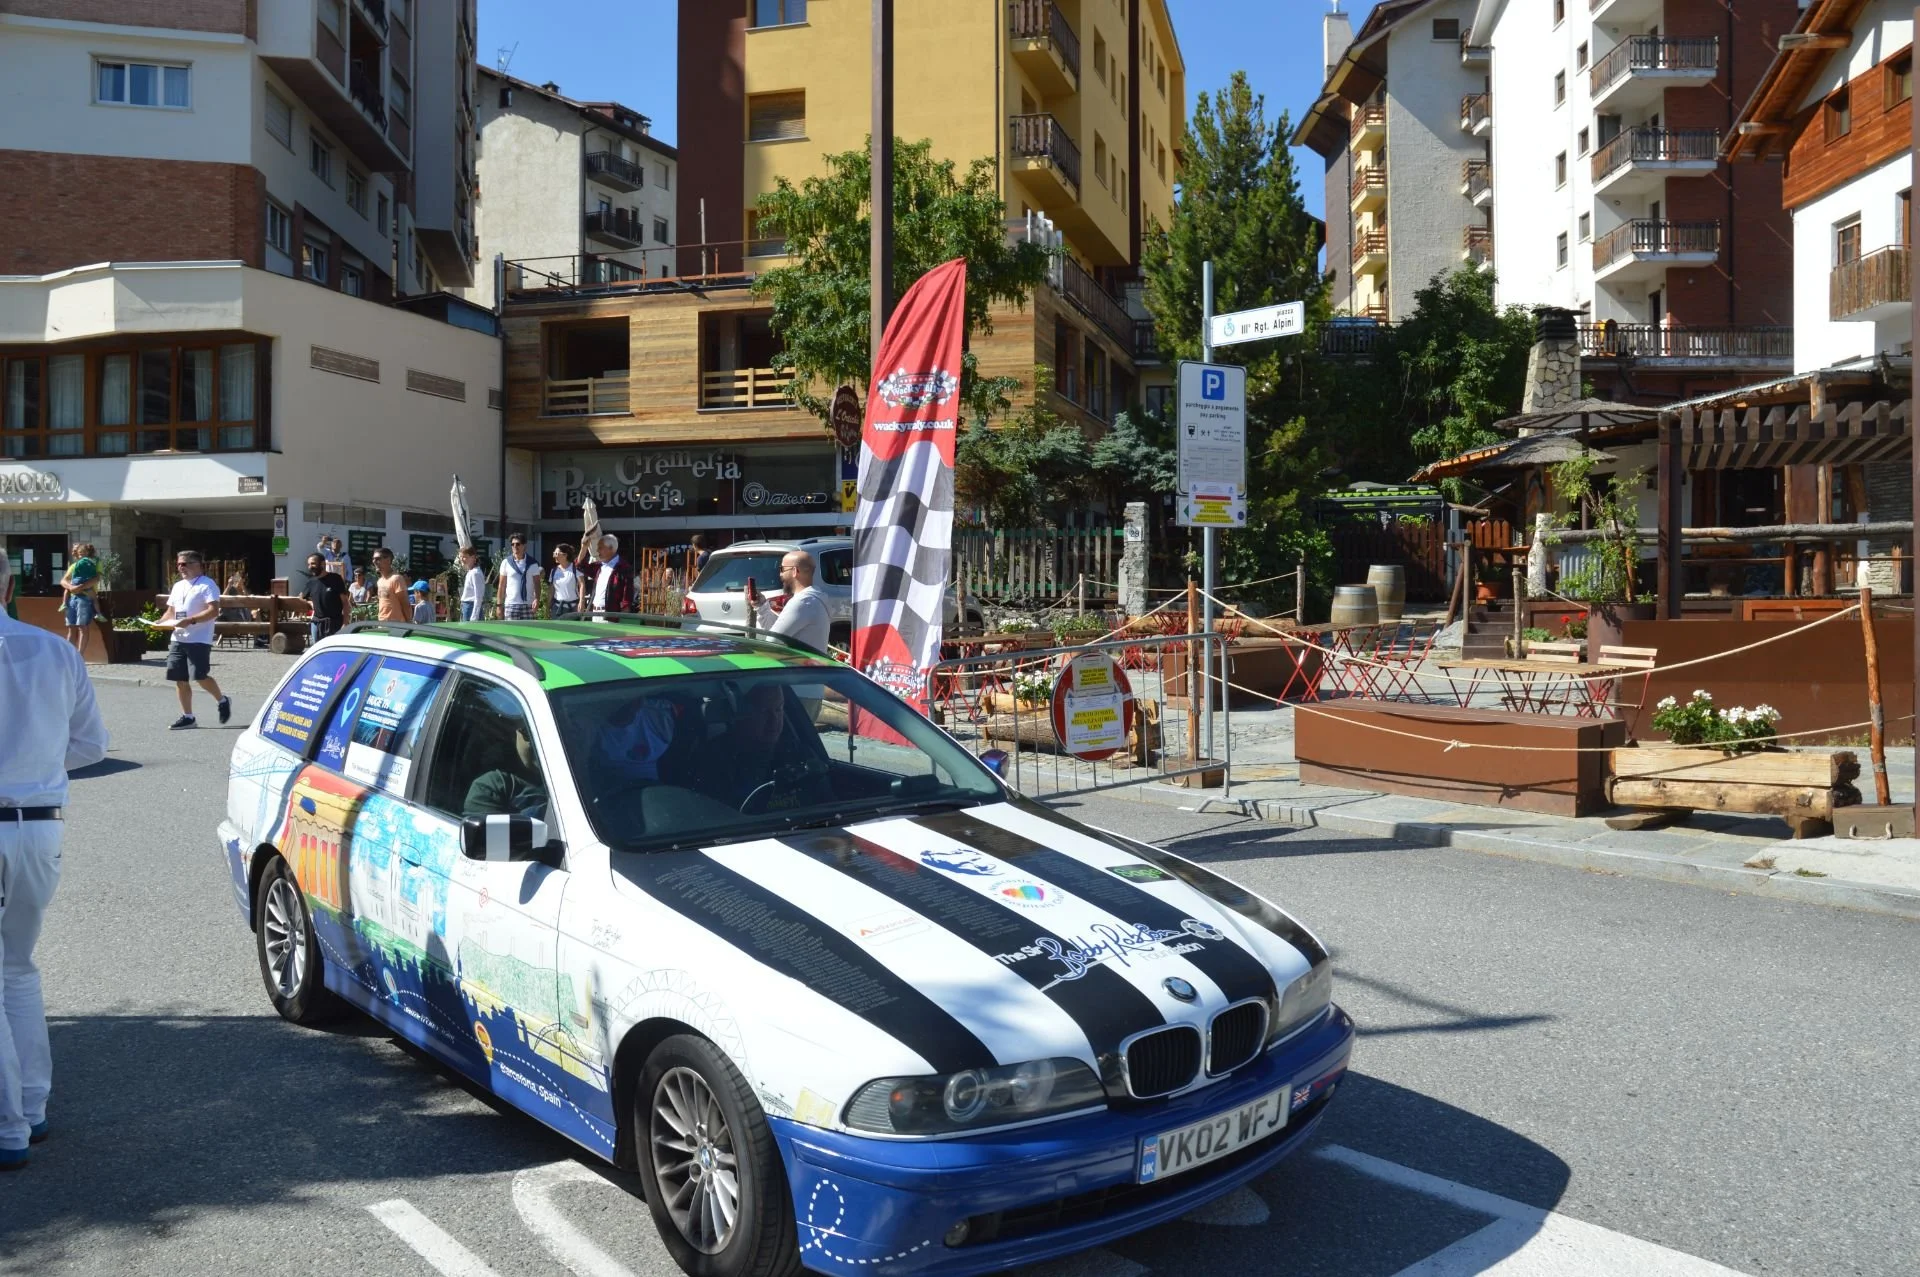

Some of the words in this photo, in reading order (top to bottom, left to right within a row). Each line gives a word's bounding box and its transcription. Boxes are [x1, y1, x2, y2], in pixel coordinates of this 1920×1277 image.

[1254, 322, 1270, 334] Rgt.
[1273, 317, 1294, 330] Alpini
[1276, 308, 1294, 317] piazza
[1206, 373, 1220, 396] P
[616, 449, 742, 486] Cremeria
[552, 466, 685, 512] Pasticceria
[995, 951, 1021, 965] The
[1020, 944, 1043, 960] Sir
[1035, 935, 1108, 981] Bobby
[1090, 922, 1181, 968] Robson
[1137, 941, 1206, 962] Foundation
[500, 1062, 538, 1096] Barcelona,
[537, 1085, 562, 1109] Spain
[1158, 1117, 1231, 1172] VK02
[1237, 1092, 1283, 1144] WFJ
[1142, 1161, 1154, 1176] UK
